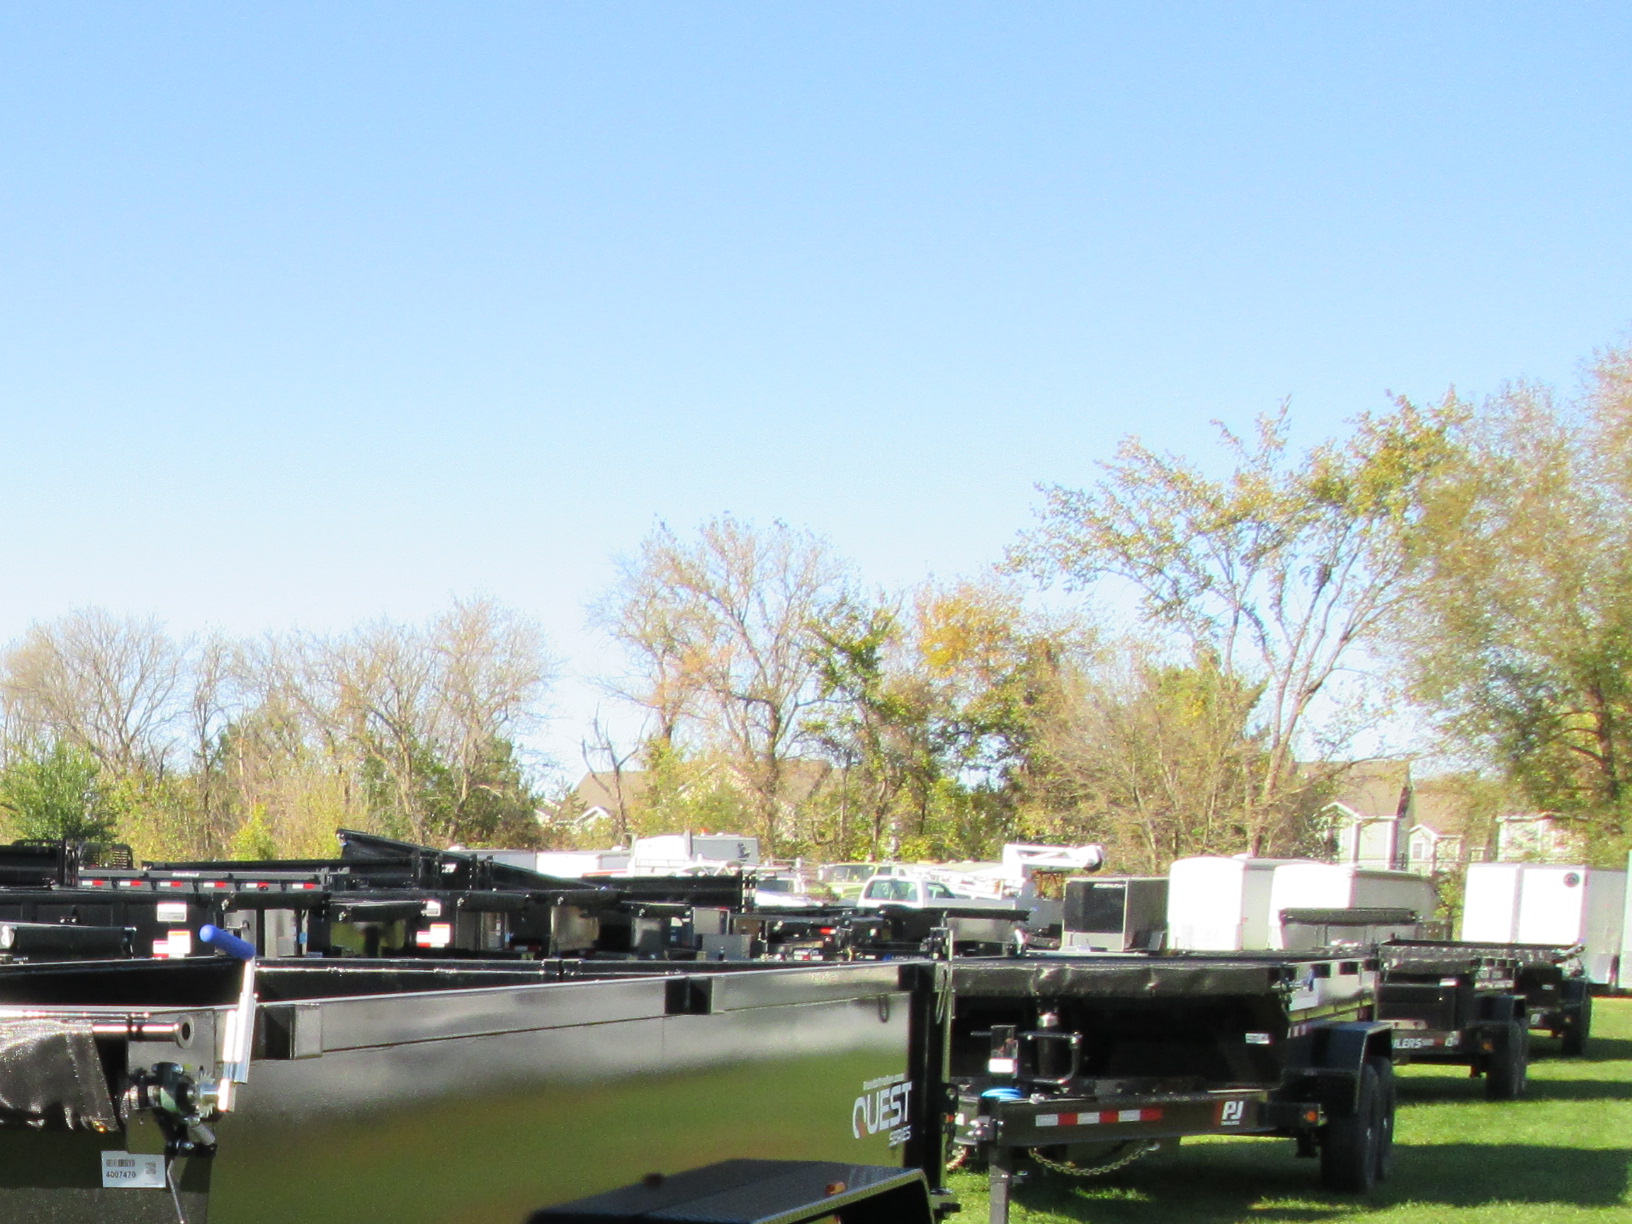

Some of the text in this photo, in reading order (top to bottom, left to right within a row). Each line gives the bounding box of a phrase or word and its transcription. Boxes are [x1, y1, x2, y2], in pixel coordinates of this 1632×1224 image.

[853, 1081, 912, 1138] QUEST
[1222, 1101, 1244, 1119] PJ
[106, 1170, 136, 1179] 4007470
